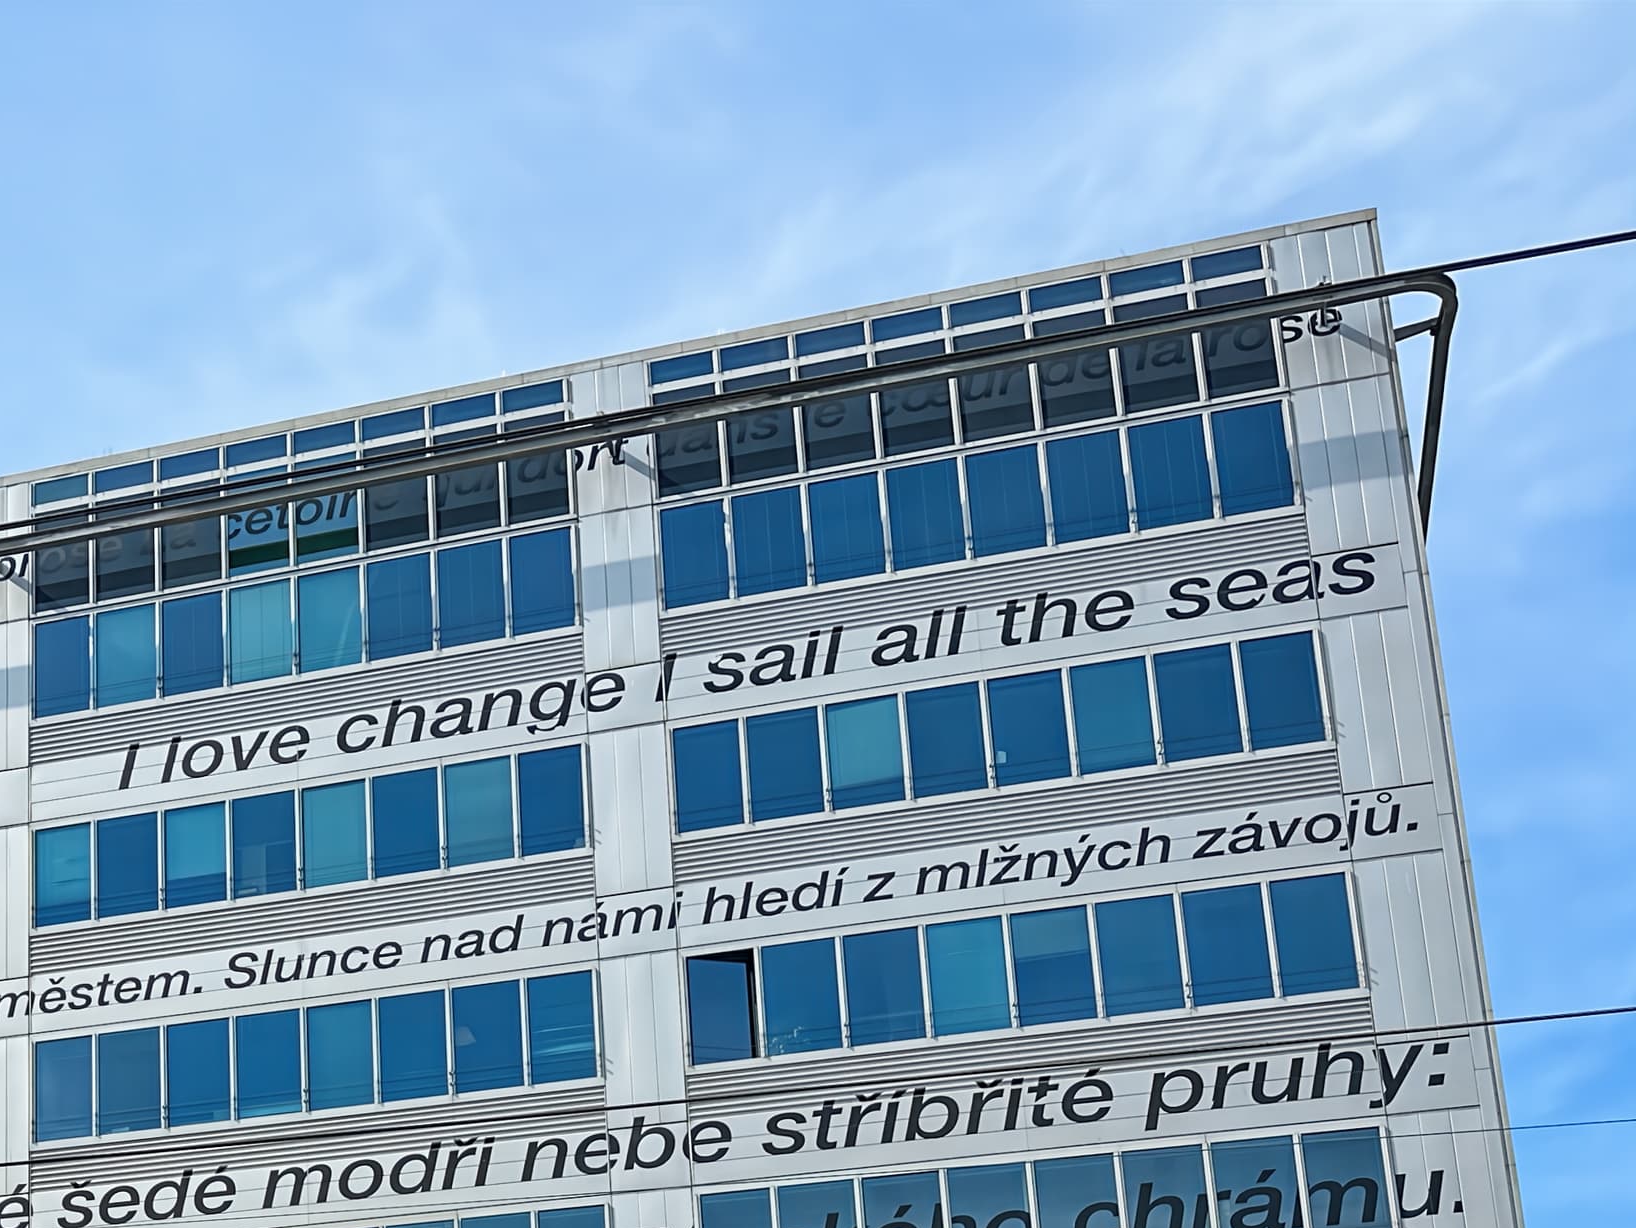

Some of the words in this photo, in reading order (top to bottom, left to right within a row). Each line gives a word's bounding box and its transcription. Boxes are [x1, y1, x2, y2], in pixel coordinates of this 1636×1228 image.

[119, 743, 140, 790] I
[160, 724, 311, 784] love
[336, 669, 626, 754] change
[654, 652, 677, 702] I
[703, 625, 844, 694] sail
[870, 605, 967, 667] all
[996, 588, 1135, 647] the
[1165, 551, 1376, 621] seas
[224, 940, 403, 990] Slunce
[420, 913, 525, 964] nad
[541, 890, 684, 947] námi
[702, 866, 851, 925] hledí
[862, 870, 896, 902] z
[915, 826, 1172, 895] mlžných
[1192, 791, 1419, 860] závojů.
[260, 1136, 496, 1210] modři
[519, 1115, 734, 1183] nebe
[762, 1068, 1115, 1157] stříbřité
[1144, 1041, 1450, 1132] pruhy:
